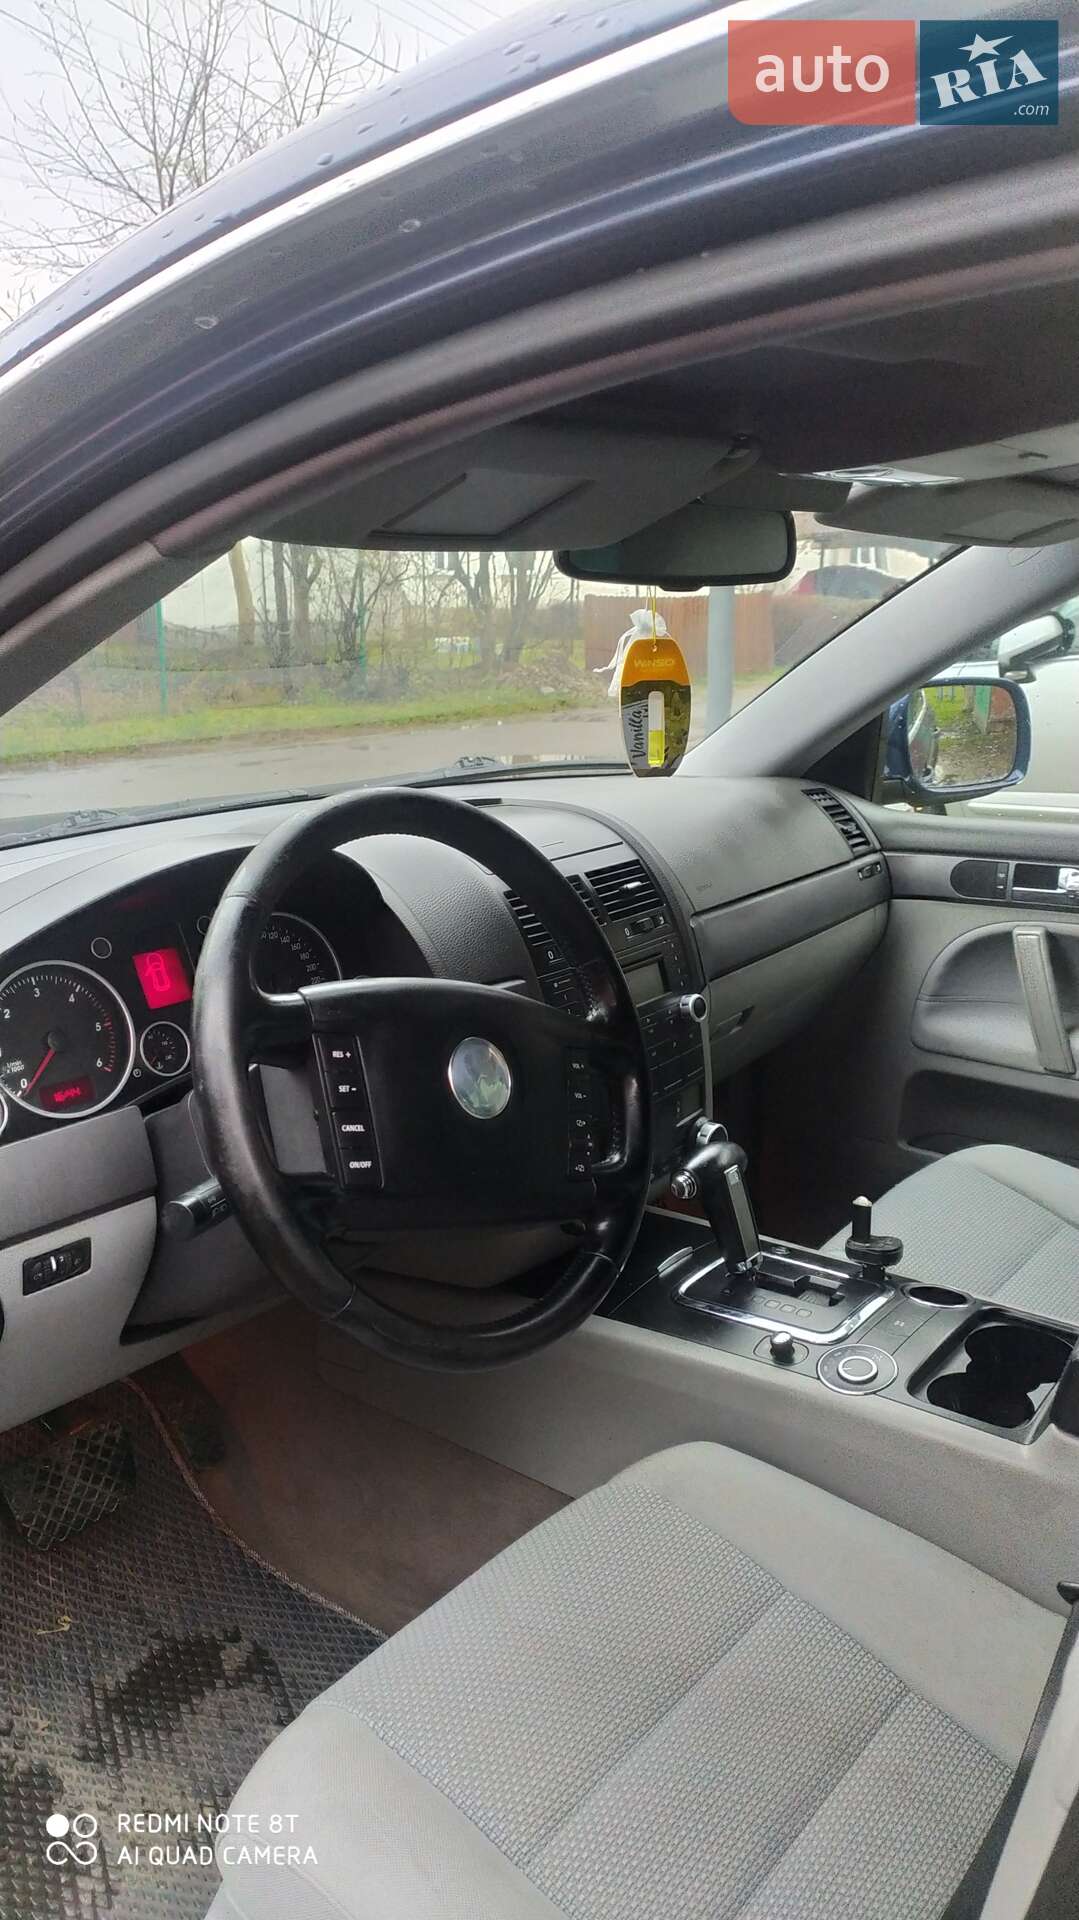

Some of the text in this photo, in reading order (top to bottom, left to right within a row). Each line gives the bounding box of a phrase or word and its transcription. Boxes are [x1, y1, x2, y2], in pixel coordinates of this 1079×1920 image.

[628, 709, 647, 759] Vanilla
[33, 988, 40, 997] 3
[69, 993, 75, 1002] 4
[3, 1008, 11, 1019] 2
[95, 1022, 101, 1031] 5
[96, 1057, 102, 1067] 6
[20, 1078, 28, 1089] 0
[338, 1085, 350, 1093] SET
[349, 1161, 372, 1169] ON/OFF
